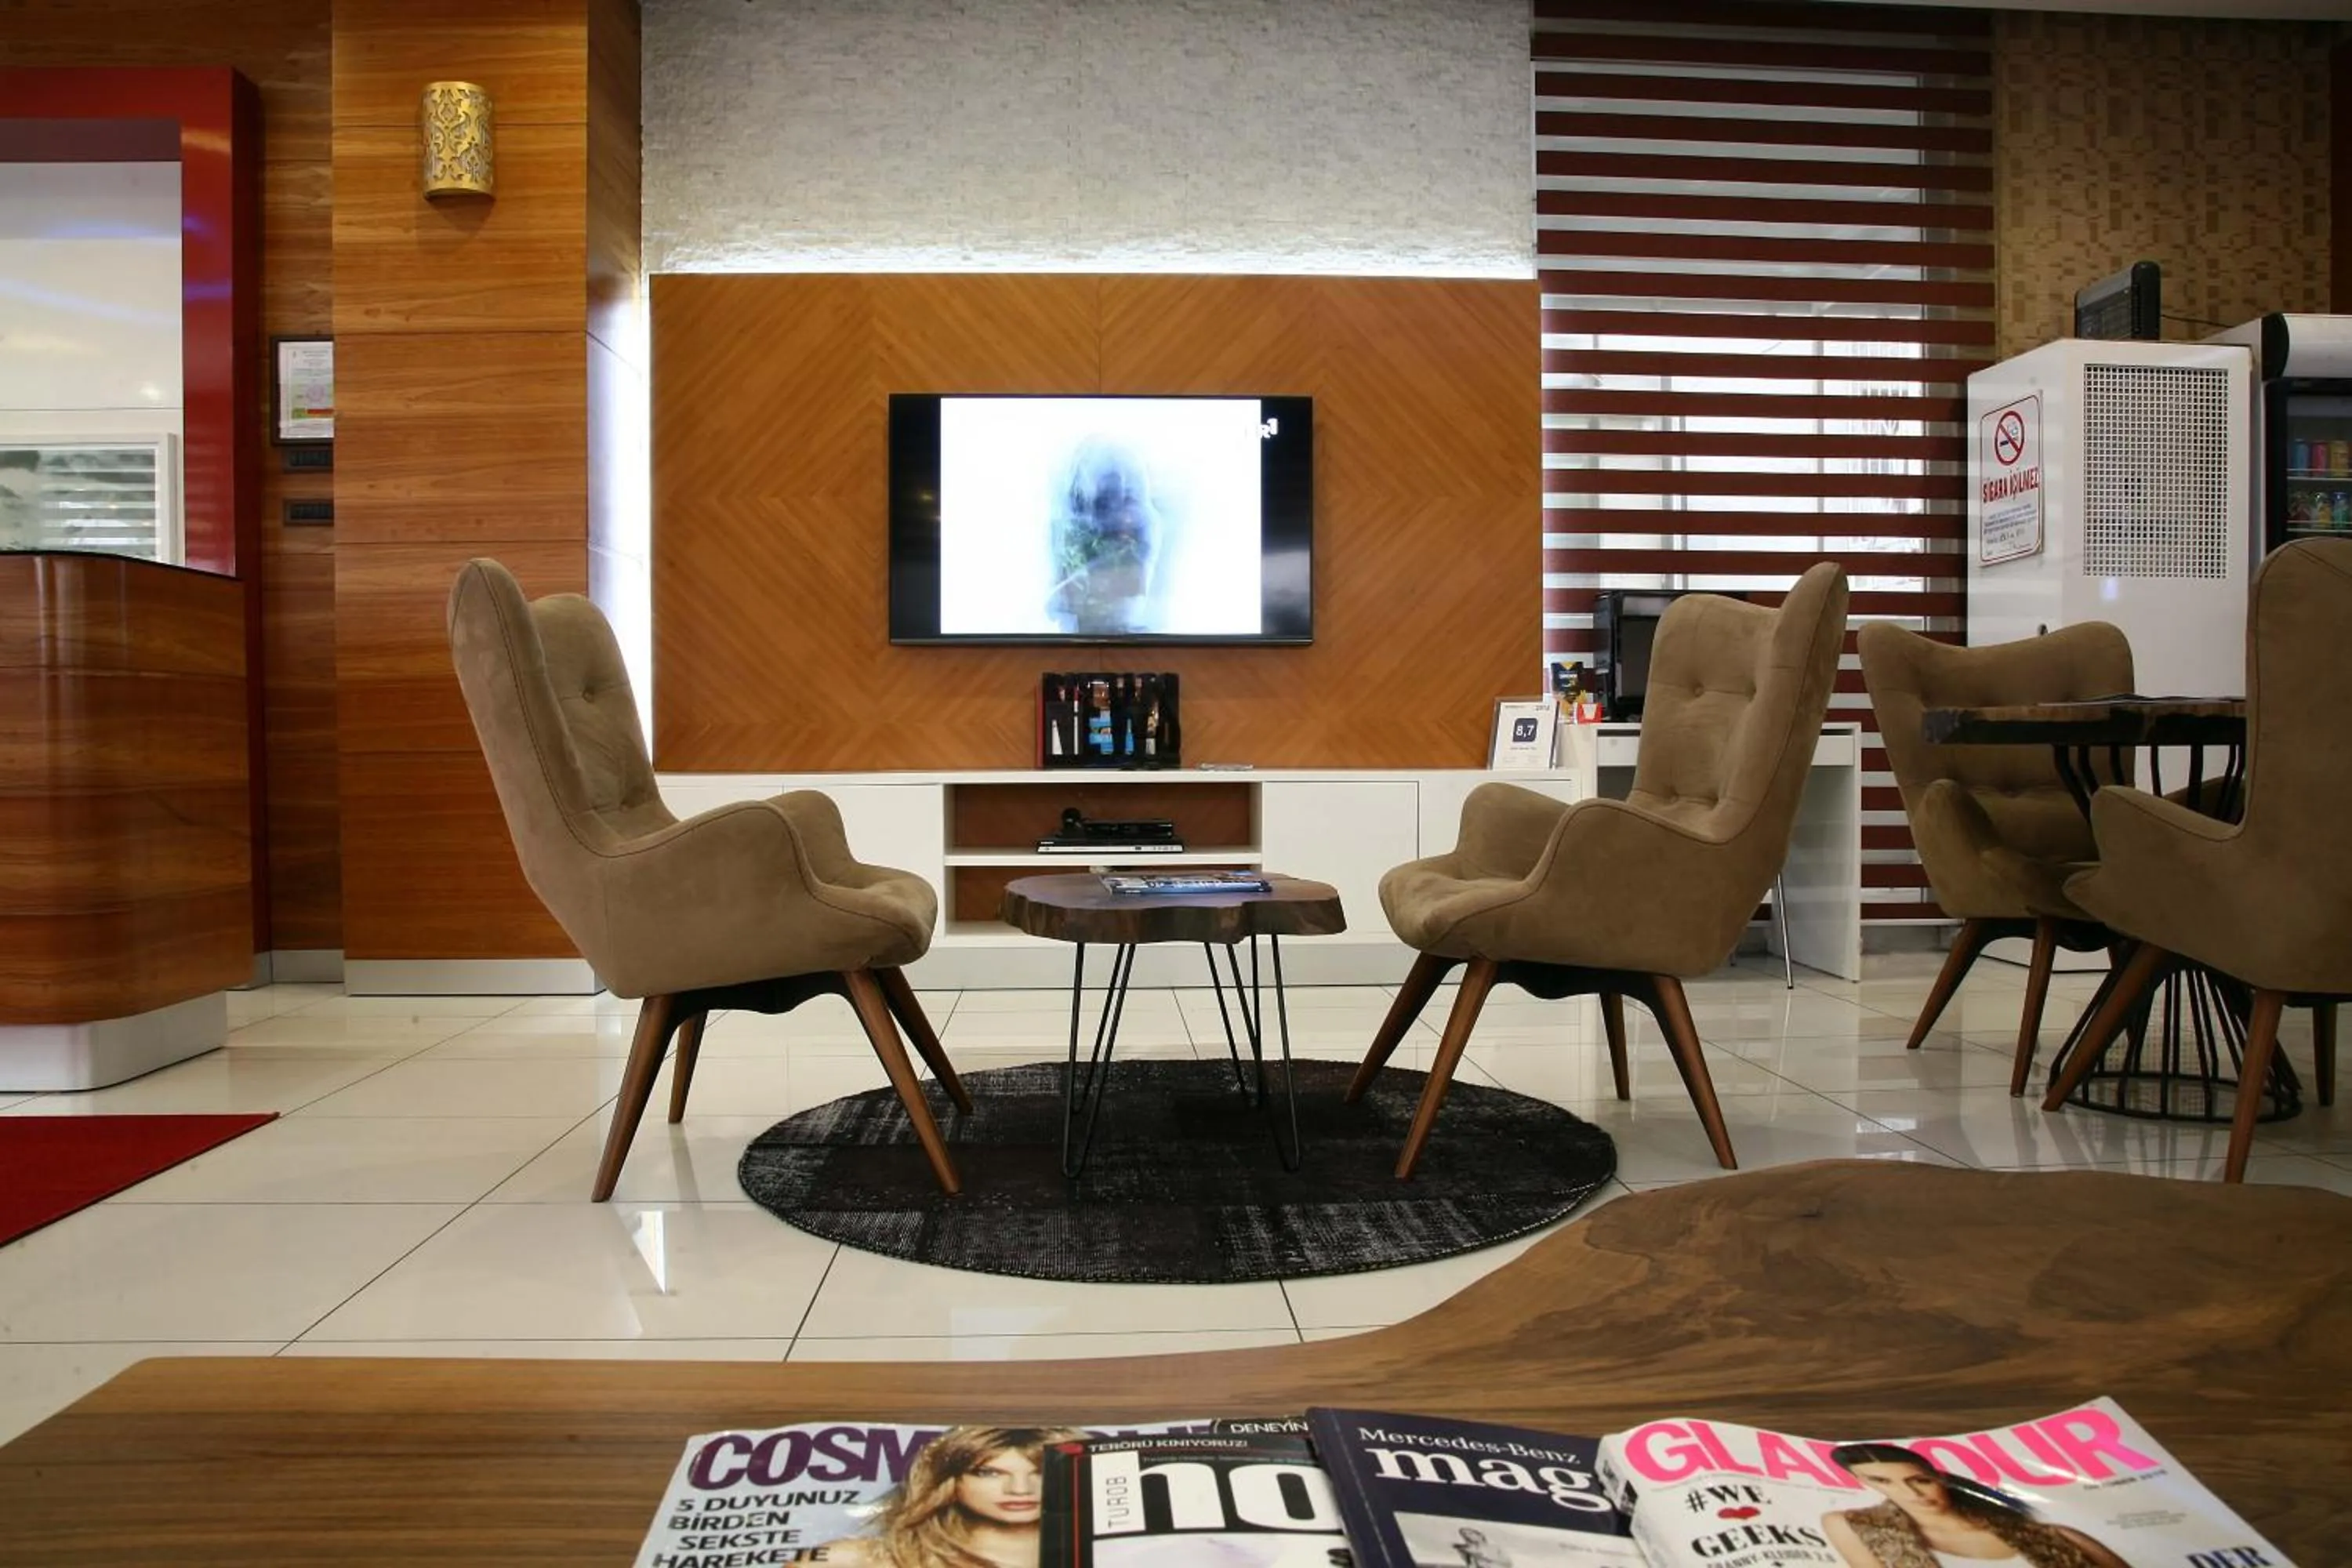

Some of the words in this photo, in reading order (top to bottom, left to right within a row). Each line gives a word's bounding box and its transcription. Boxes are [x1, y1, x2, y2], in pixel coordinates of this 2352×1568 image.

[1515, 725, 1534, 738] 8,7
[1229, 1421, 1309, 1434] DENEYİN
[1357, 1427, 1581, 1465] Mercedes-Benz
[1365, 1448, 1612, 1512] mag
[676, 1498, 694, 1512] 5
[704, 1489, 862, 1512] DUYUNUZ
[1105, 1475, 1130, 1530] TUROB
[1686, 1485, 1772, 1513] #WE
[669, 1511, 790, 1530] BİRDEN
[677, 1529, 802, 1551] SEKSTE
[1692, 1524, 1828, 1558] GEEKS
[652, 1547, 831, 1568] HAREKETE
[2185, 1546, 2273, 1568] DER
